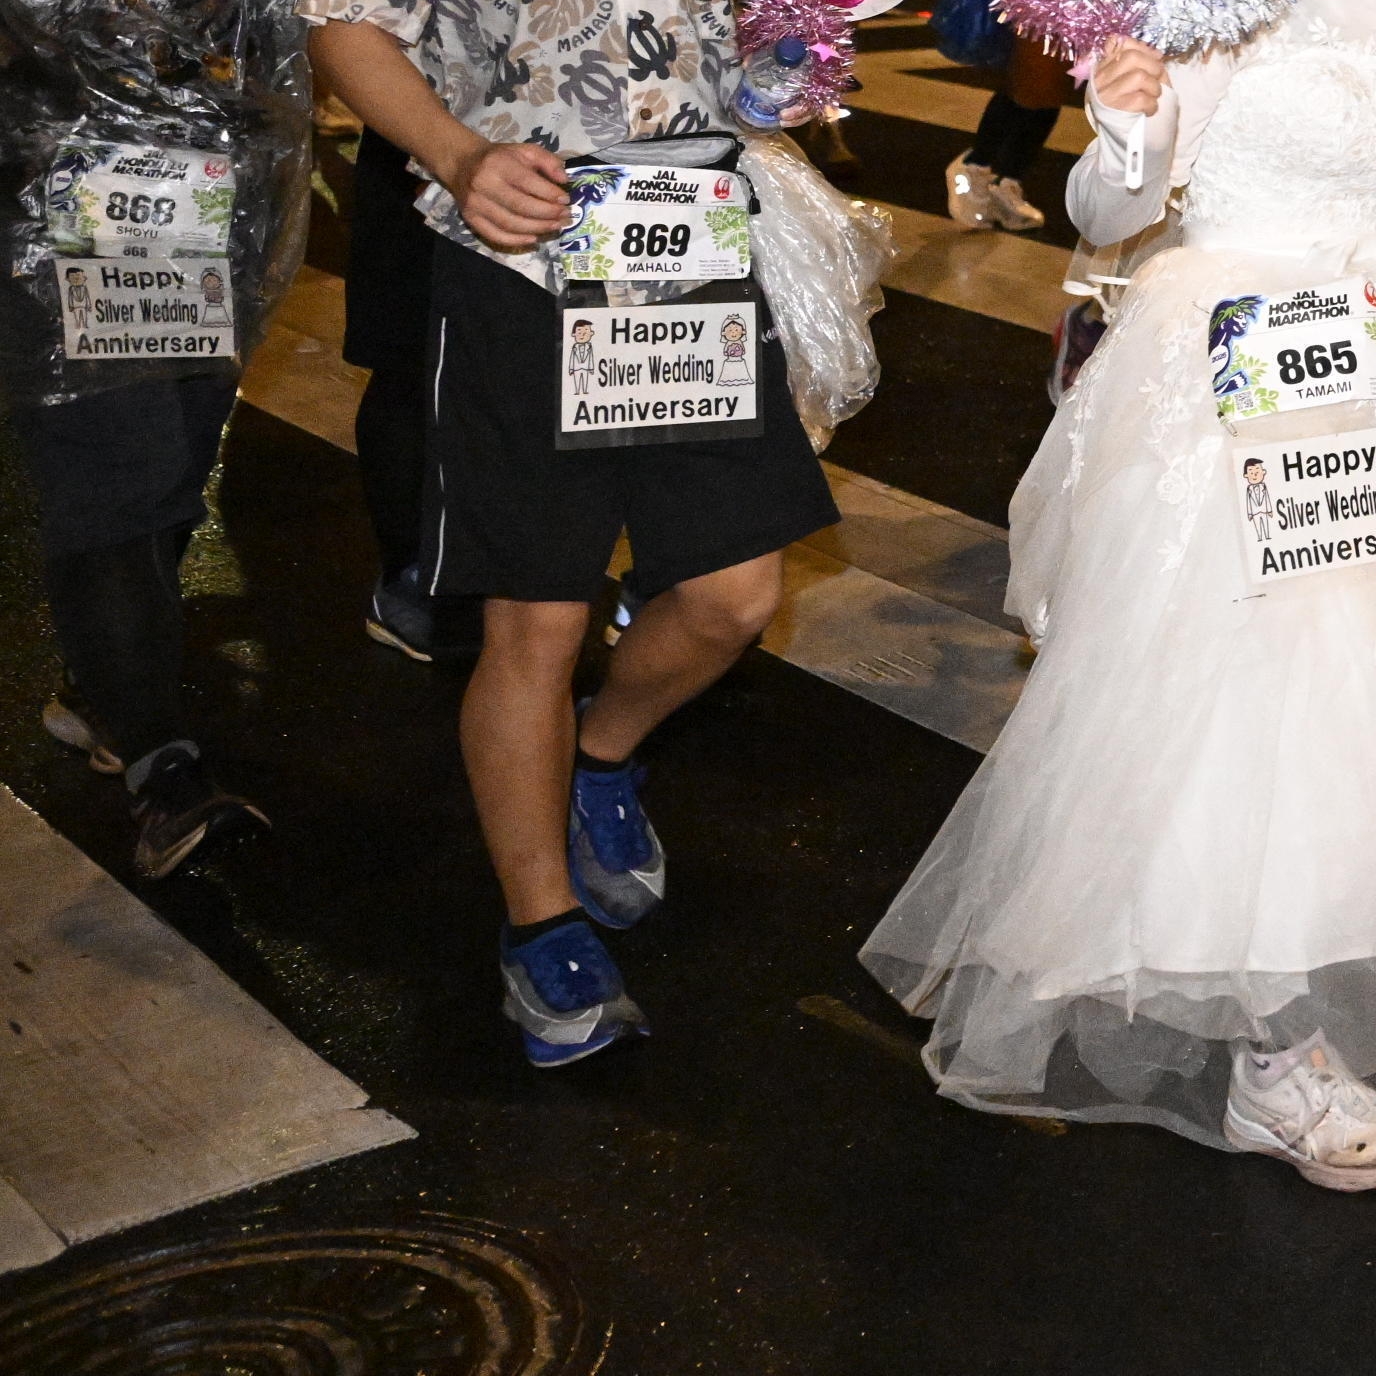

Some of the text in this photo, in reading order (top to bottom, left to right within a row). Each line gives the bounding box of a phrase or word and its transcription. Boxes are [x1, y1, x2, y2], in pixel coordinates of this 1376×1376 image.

[556, 0, 615, 54] MAHALO
[628, 180, 700, 194] HONOLULU
[652, 170, 678, 181] JAL
[105, 191, 176, 227] 868
[625, 190, 697, 204] MARATHON
[116, 225, 159, 239] SHOYU
[620, 223, 691, 258] 869
[101, 266, 186, 290] Happy
[626, 262, 683, 273] MAHALO
[1268, 293, 1348, 316] HONOLULU
[1292, 289, 1320, 301] JAL
[94, 298, 198, 325] Silver Wedding
[1267, 305, 1350, 329] MARATHON
[610, 317, 705, 345] Happy
[76, 332, 220, 355] Anniversary
[598, 353, 714, 388] Silver Wedding
[1276, 339, 1358, 385] 865
[1295, 380, 1353, 400] TAMAMI
[572, 395, 740, 426] Anniversary
[1281, 446, 1376, 483] Happy
[1275, 497, 1320, 531] Silver
